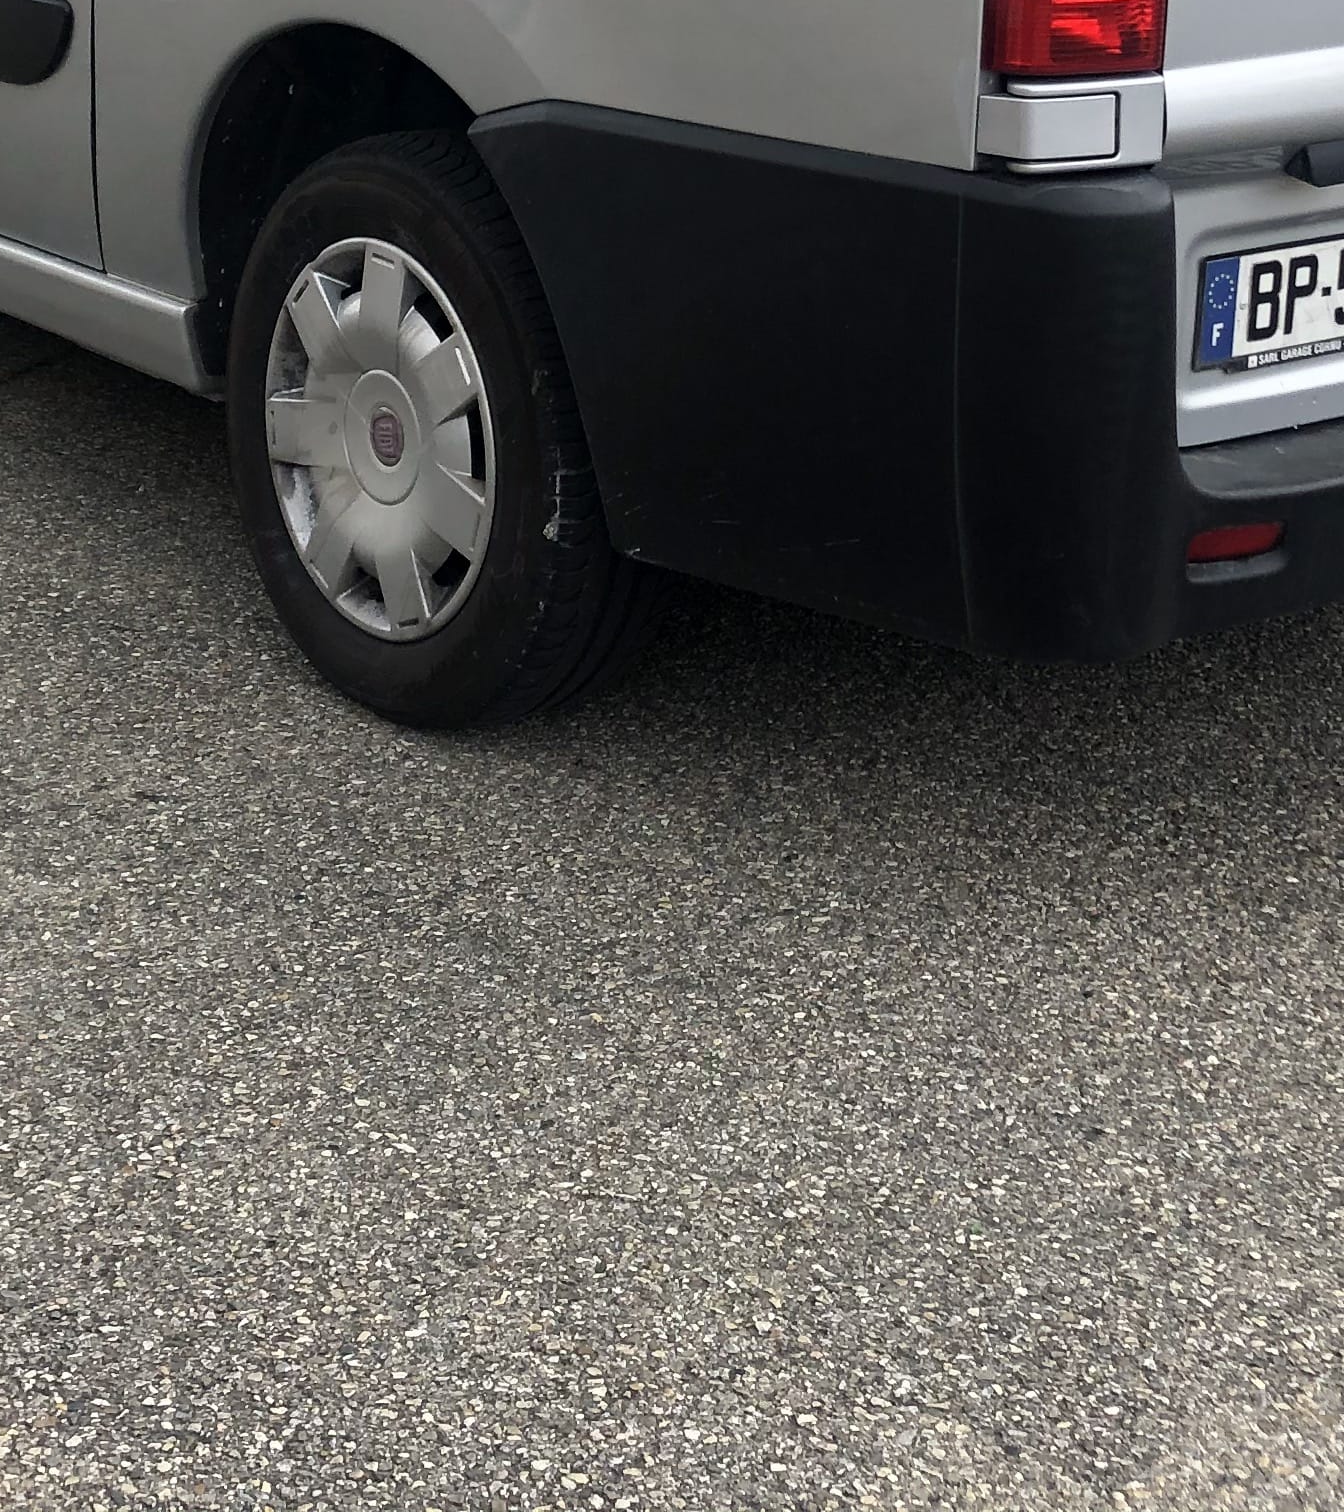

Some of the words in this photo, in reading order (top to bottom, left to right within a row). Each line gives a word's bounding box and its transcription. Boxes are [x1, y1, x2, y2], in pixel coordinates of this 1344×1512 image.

[1210, 322, 1225, 347] F
[1258, 353, 1279, 365] SARL
[1281, 345, 1312, 360] GARAGE
